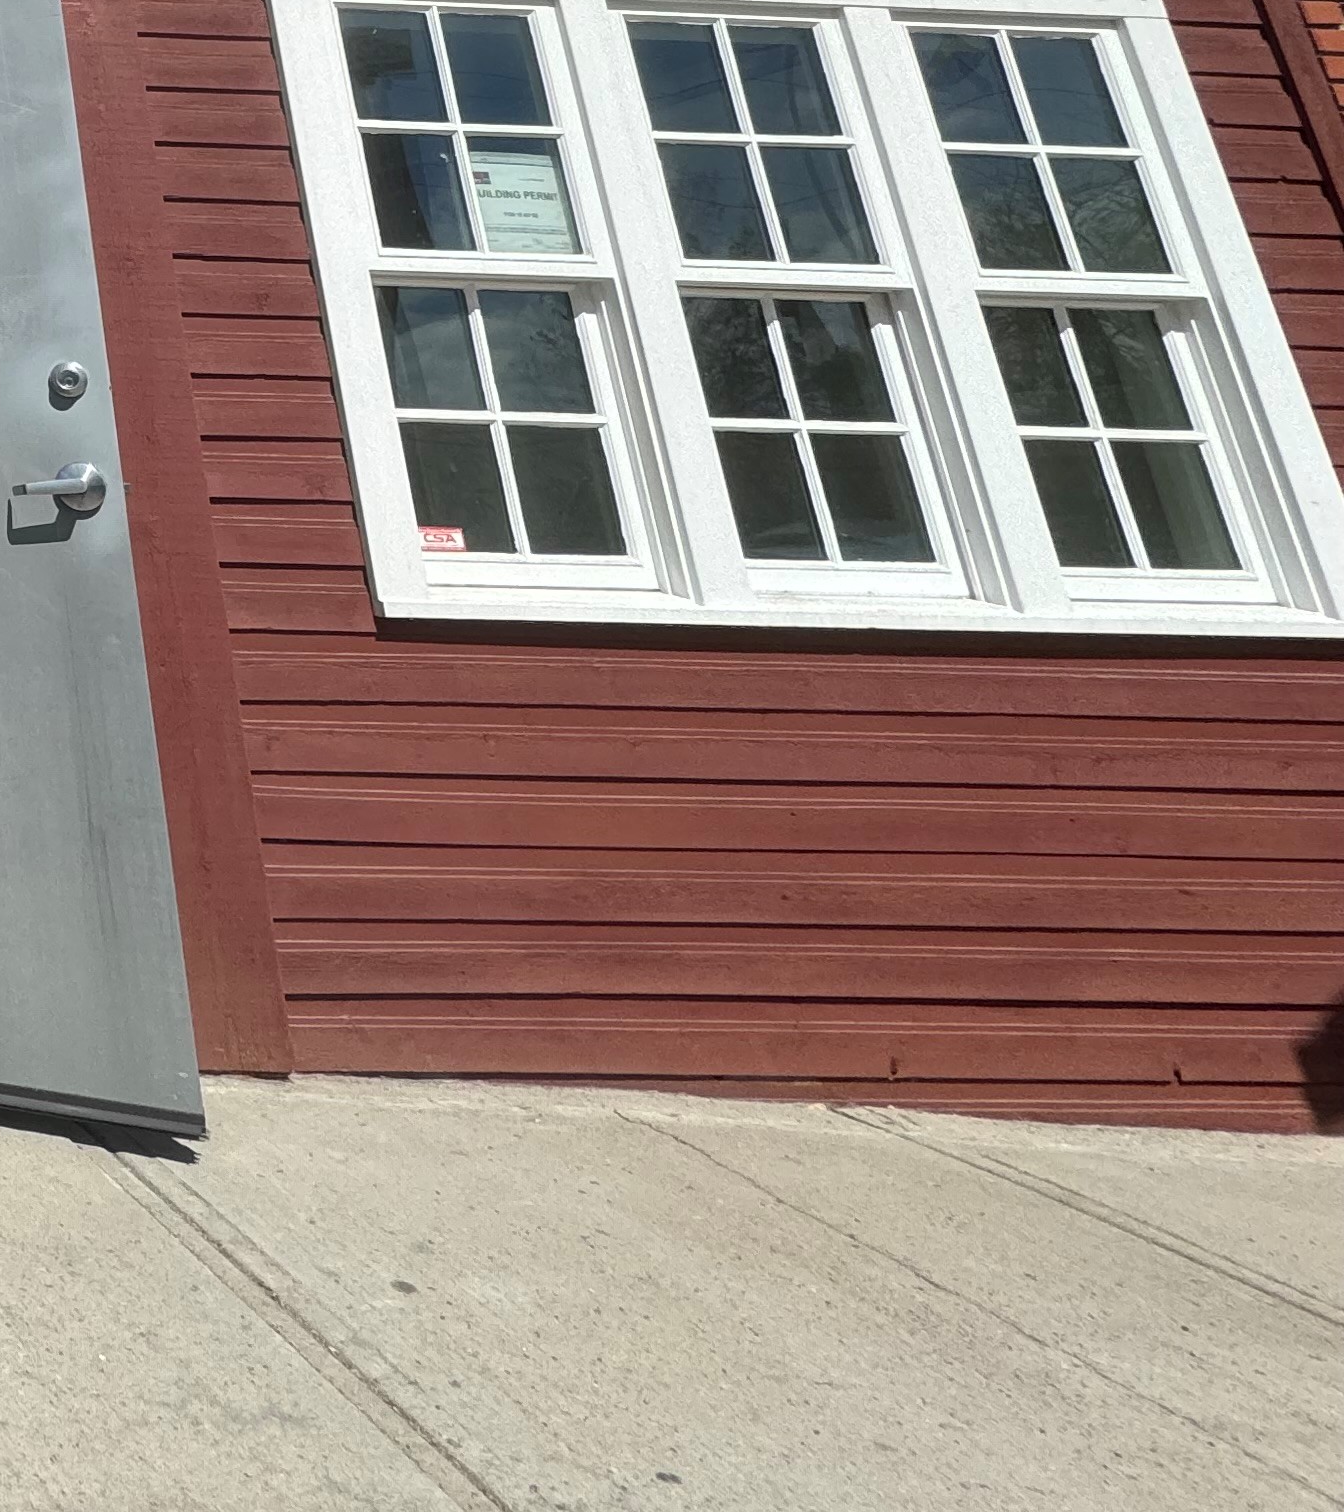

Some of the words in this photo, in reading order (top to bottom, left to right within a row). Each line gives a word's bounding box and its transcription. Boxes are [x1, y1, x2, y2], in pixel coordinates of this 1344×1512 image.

[478, 190, 520, 199] UILDING
[523, 190, 557, 201] PERMIT
[423, 533, 456, 543] CSA
